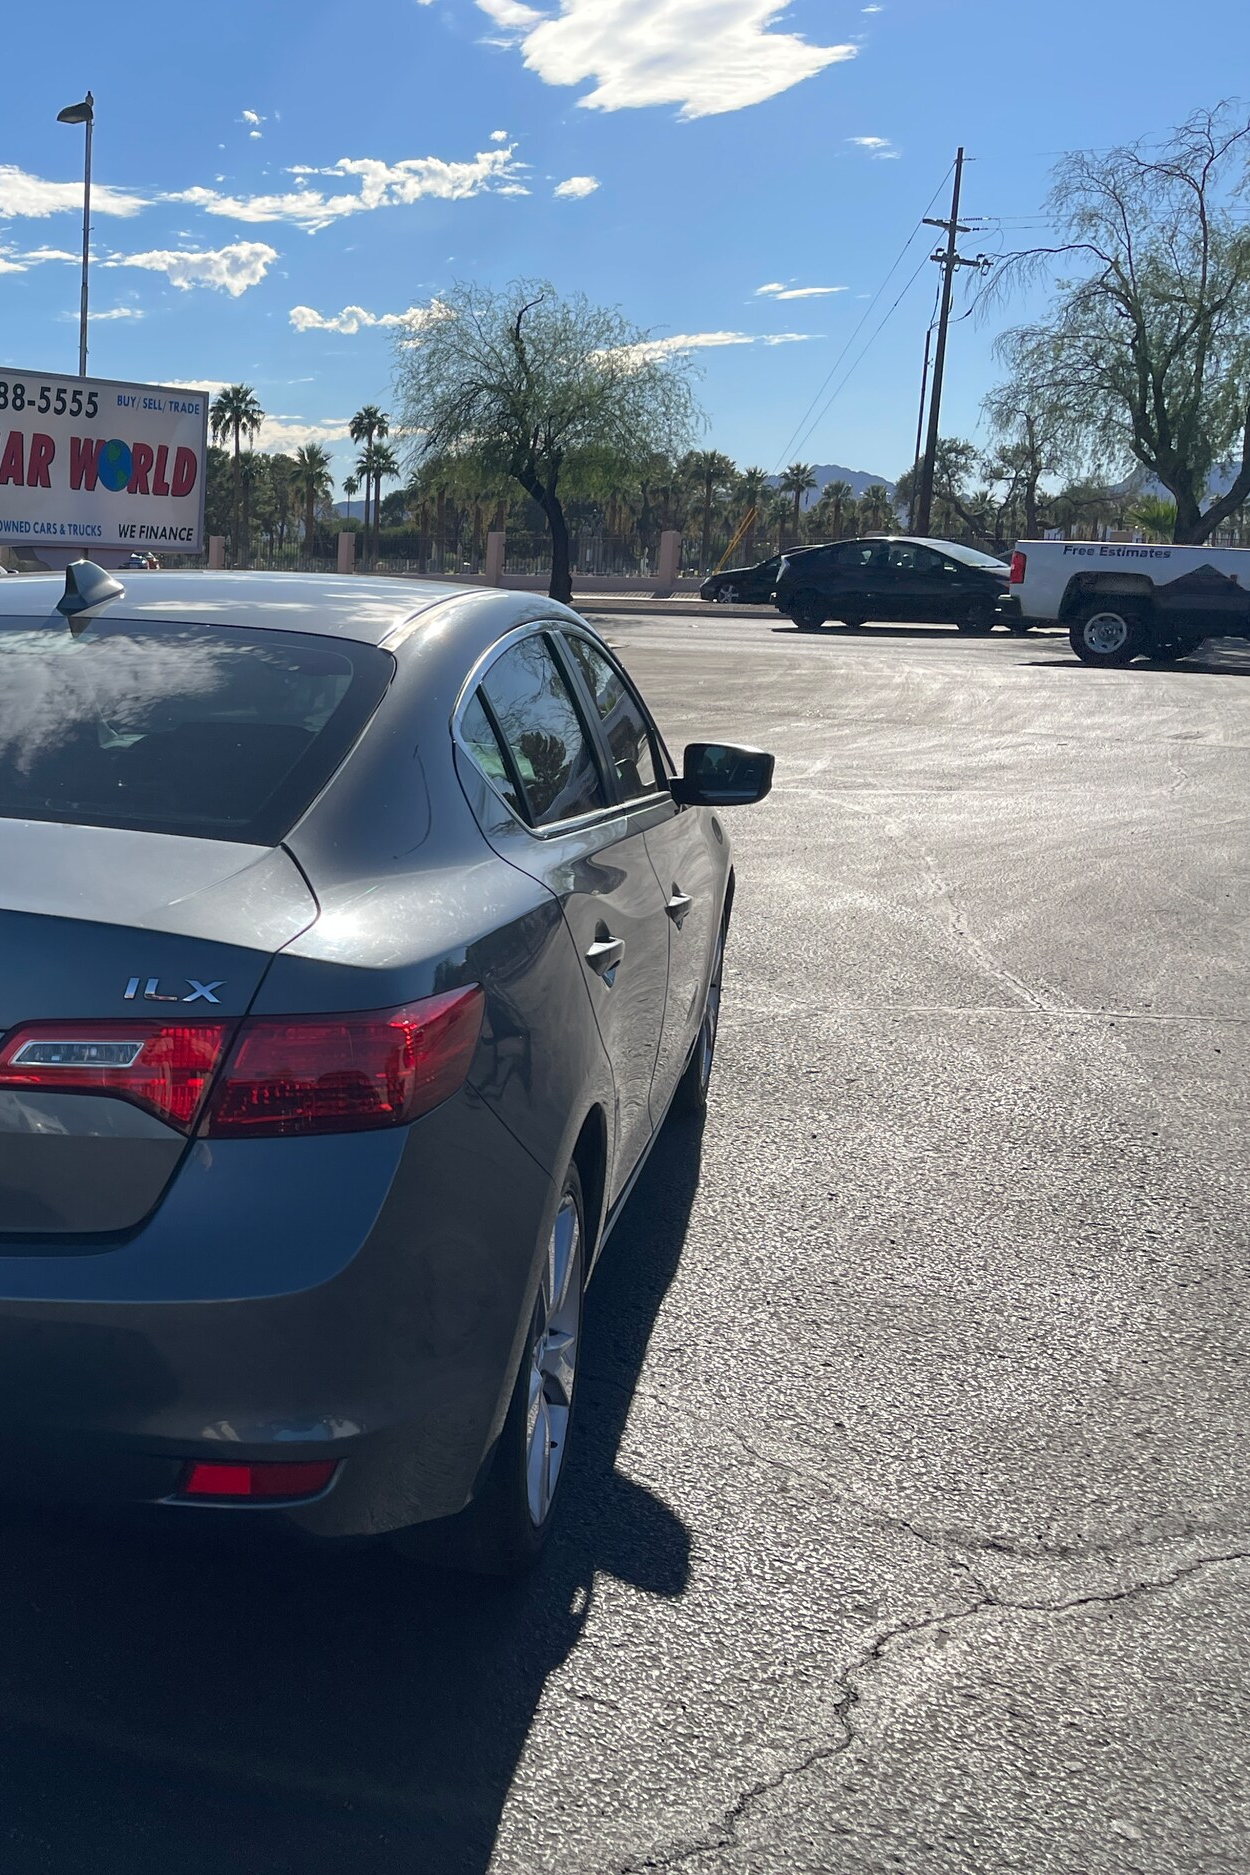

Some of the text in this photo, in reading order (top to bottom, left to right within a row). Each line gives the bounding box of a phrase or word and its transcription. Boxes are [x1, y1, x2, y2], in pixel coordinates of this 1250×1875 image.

[169, 400, 200, 415] TRADE
[70, 436, 198, 498] WORLD
[32, 521, 58, 535] CARS
[59, 523, 66, 535] &
[67, 523, 103, 537] TRUCKS
[118, 523, 194, 542] WE FINANCE
[1063, 545, 1172, 559] Free Estimates
[123, 977, 228, 1004] ILX
